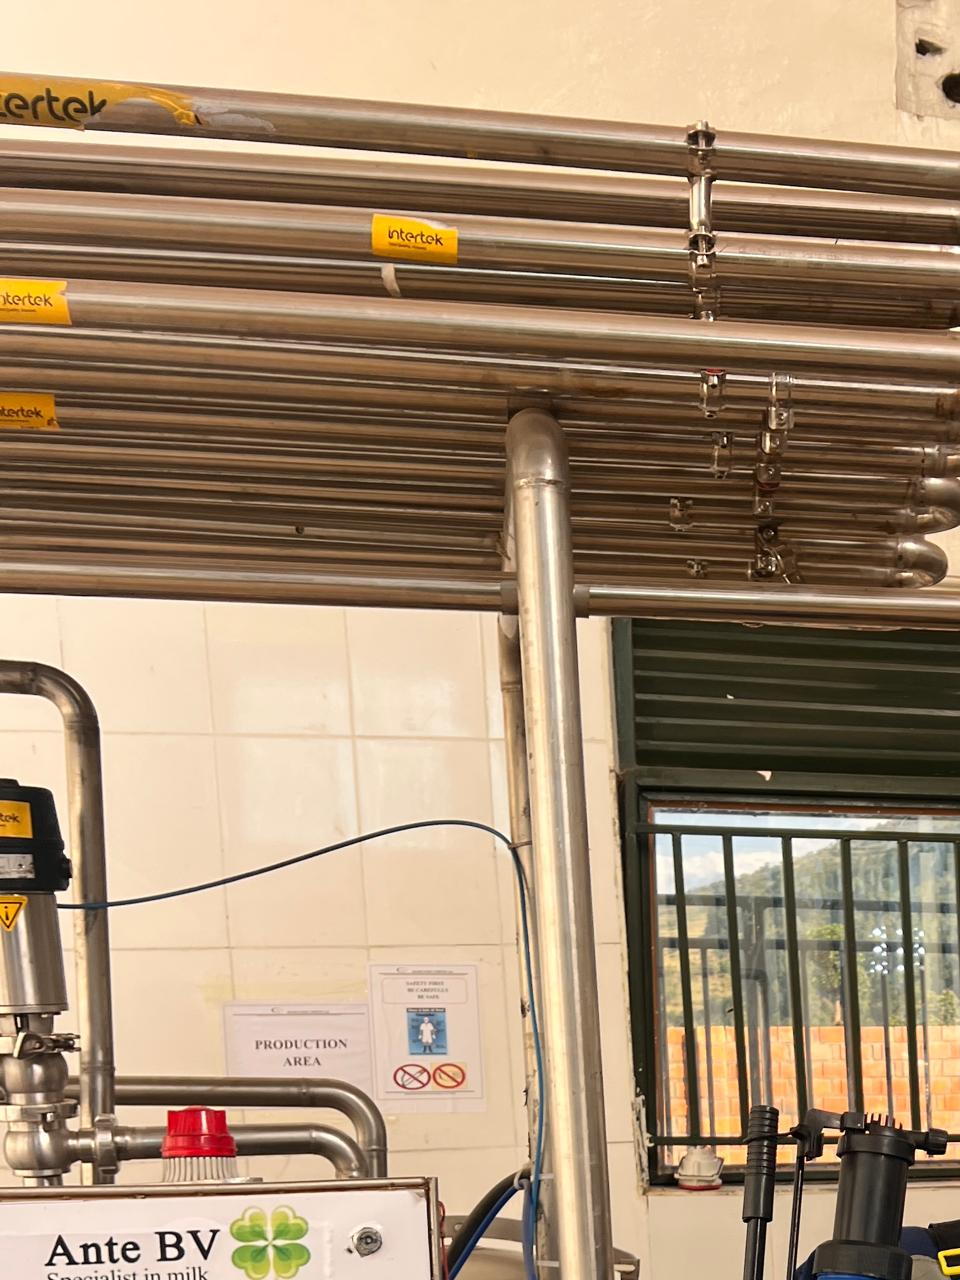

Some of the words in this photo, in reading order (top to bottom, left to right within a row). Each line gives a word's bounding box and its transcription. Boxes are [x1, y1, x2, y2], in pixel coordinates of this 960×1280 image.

[388, 226, 444, 246] intertek
[255, 1039, 348, 1050] PRODUCTION
[283, 1056, 322, 1067] AREA
[44, 1234, 141, 1267] Ante
[155, 1229, 220, 1262] BV
